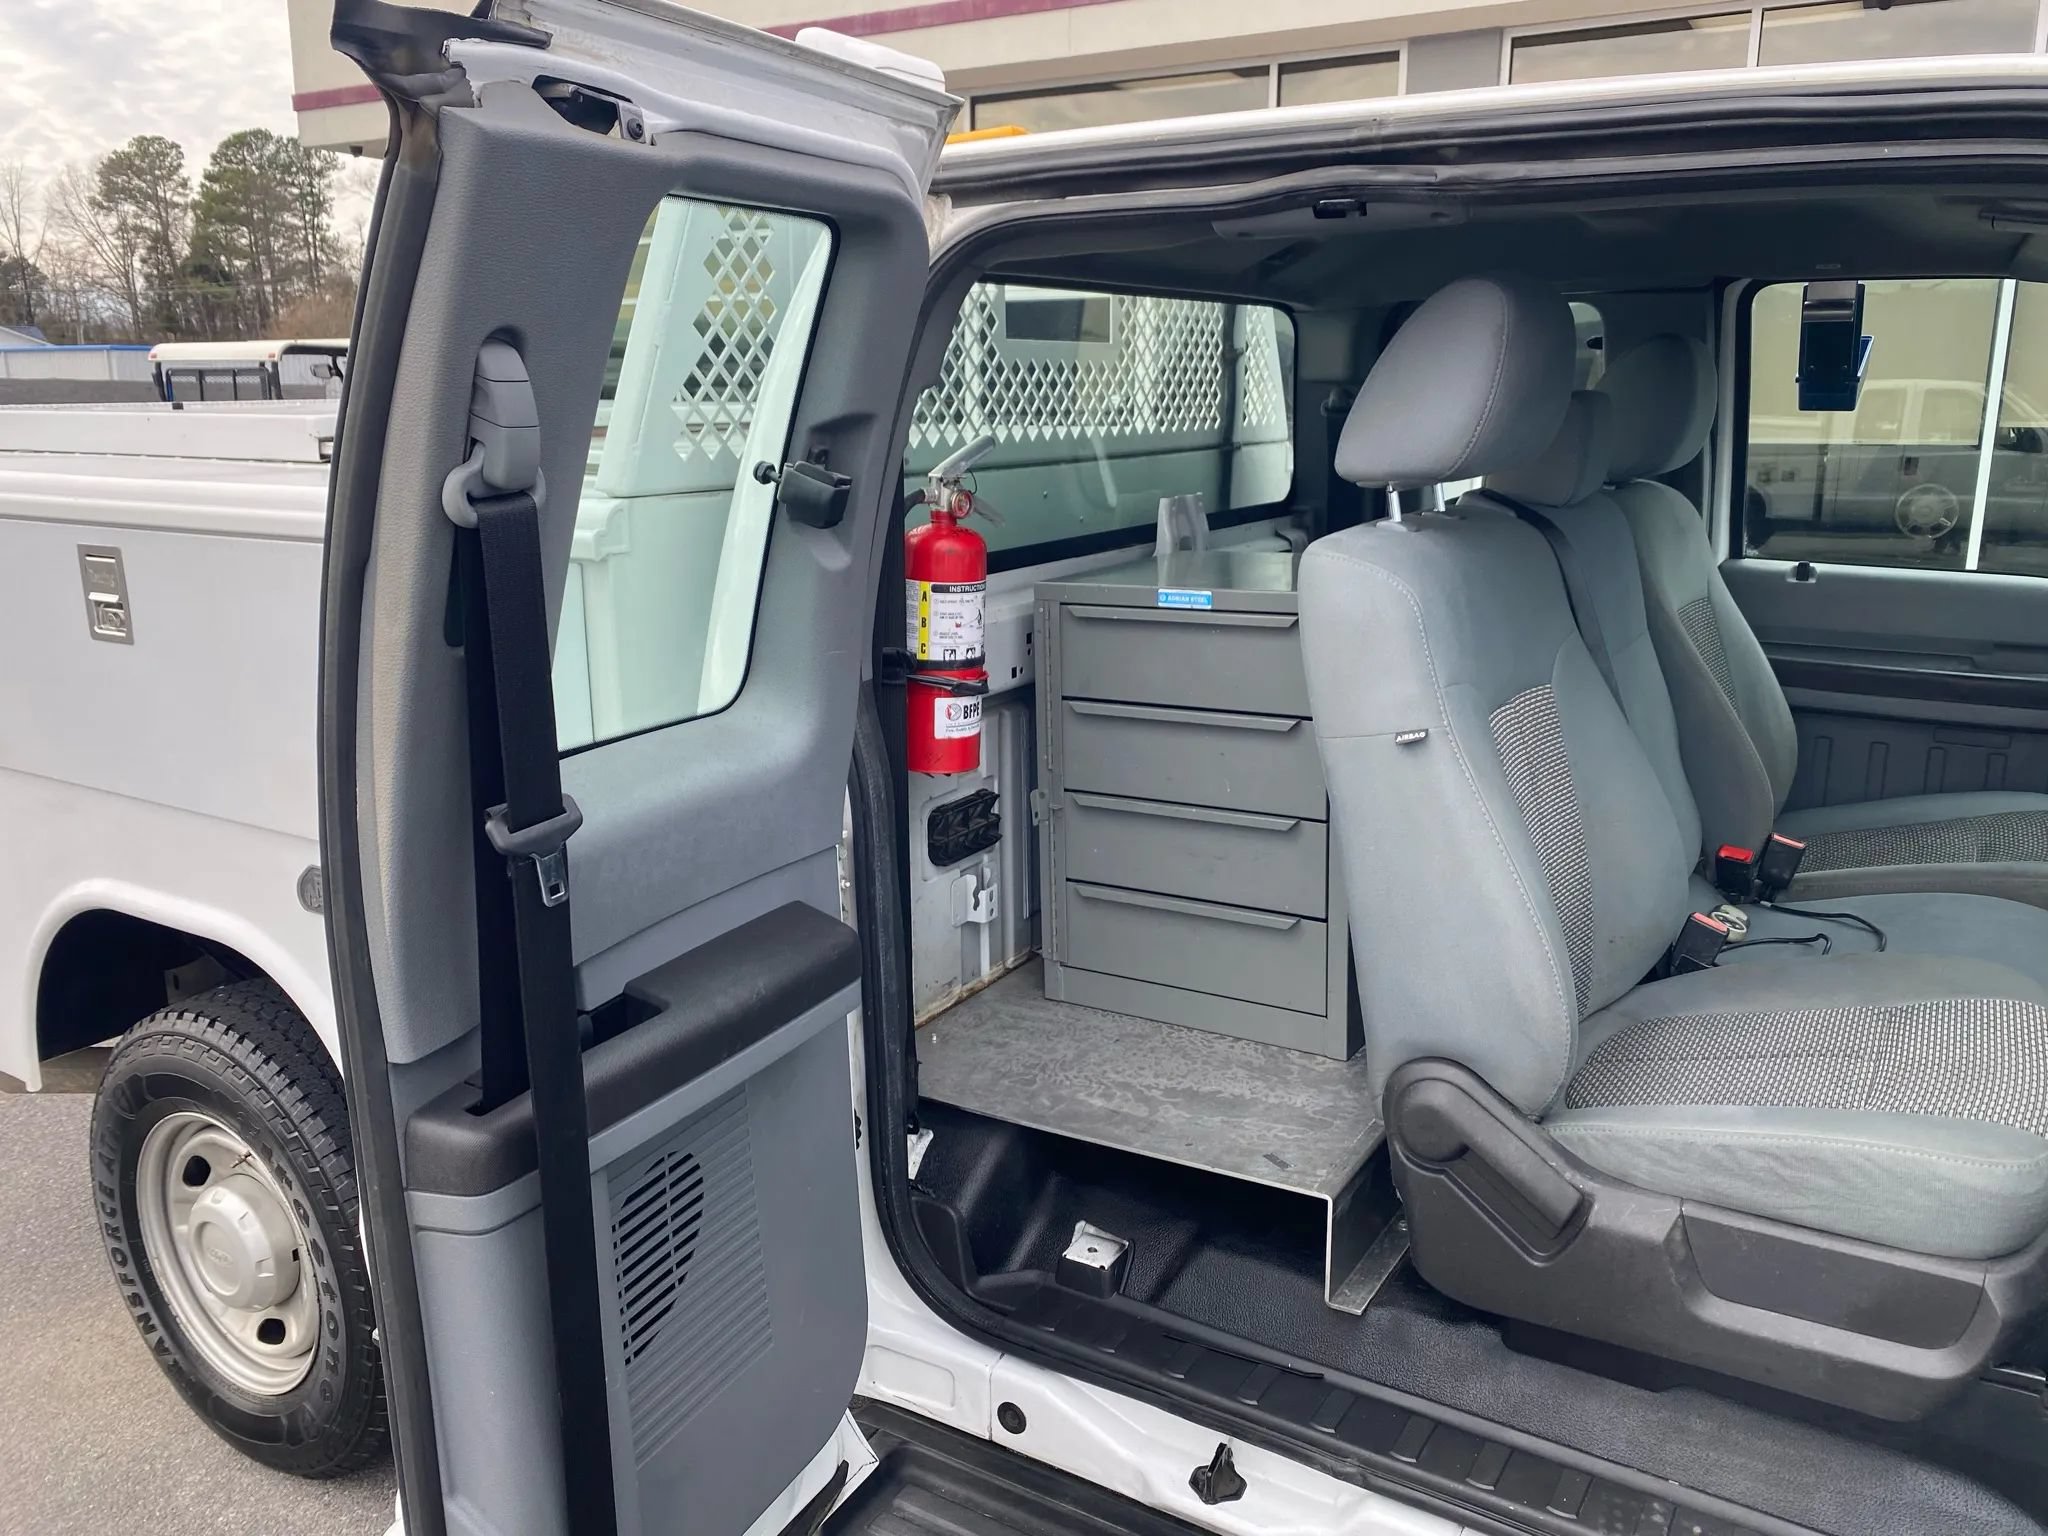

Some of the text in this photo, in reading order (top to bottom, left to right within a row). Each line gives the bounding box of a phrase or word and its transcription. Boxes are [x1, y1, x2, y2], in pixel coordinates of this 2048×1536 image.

[949, 584, 985, 593] INSTRUCTIO
[920, 591, 927, 654] A B C
[963, 701, 980, 720] BFPE
[1396, 731, 1425, 742] AIRBAG
